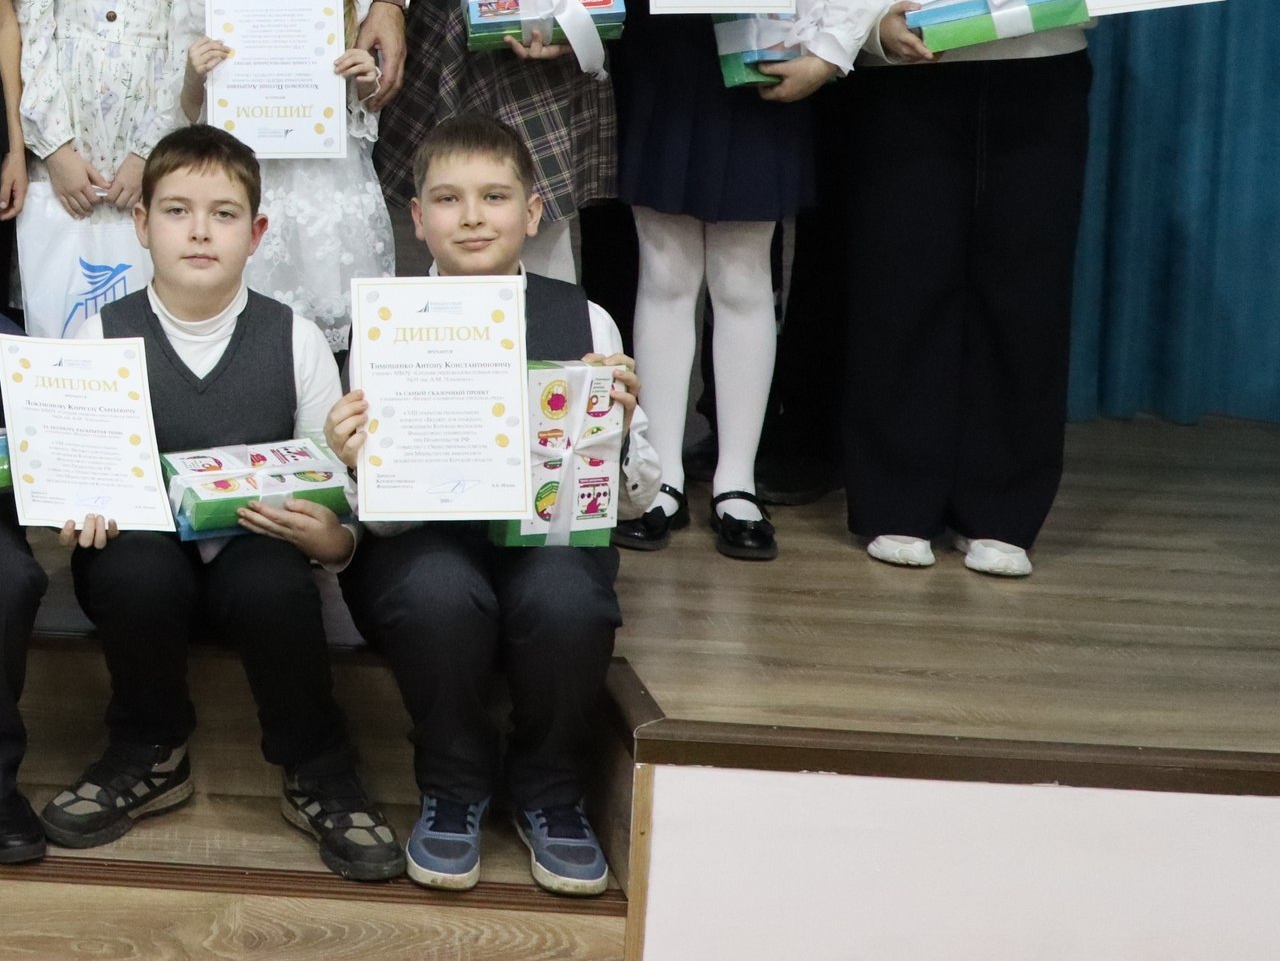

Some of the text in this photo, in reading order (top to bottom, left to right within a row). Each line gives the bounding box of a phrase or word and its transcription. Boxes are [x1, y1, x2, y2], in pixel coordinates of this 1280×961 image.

[236, 105, 315, 119] ДИПЛОМ
[393, 326, 492, 344] ДИПЛОМ
[34, 375, 119, 392] ДИПЛОМ
